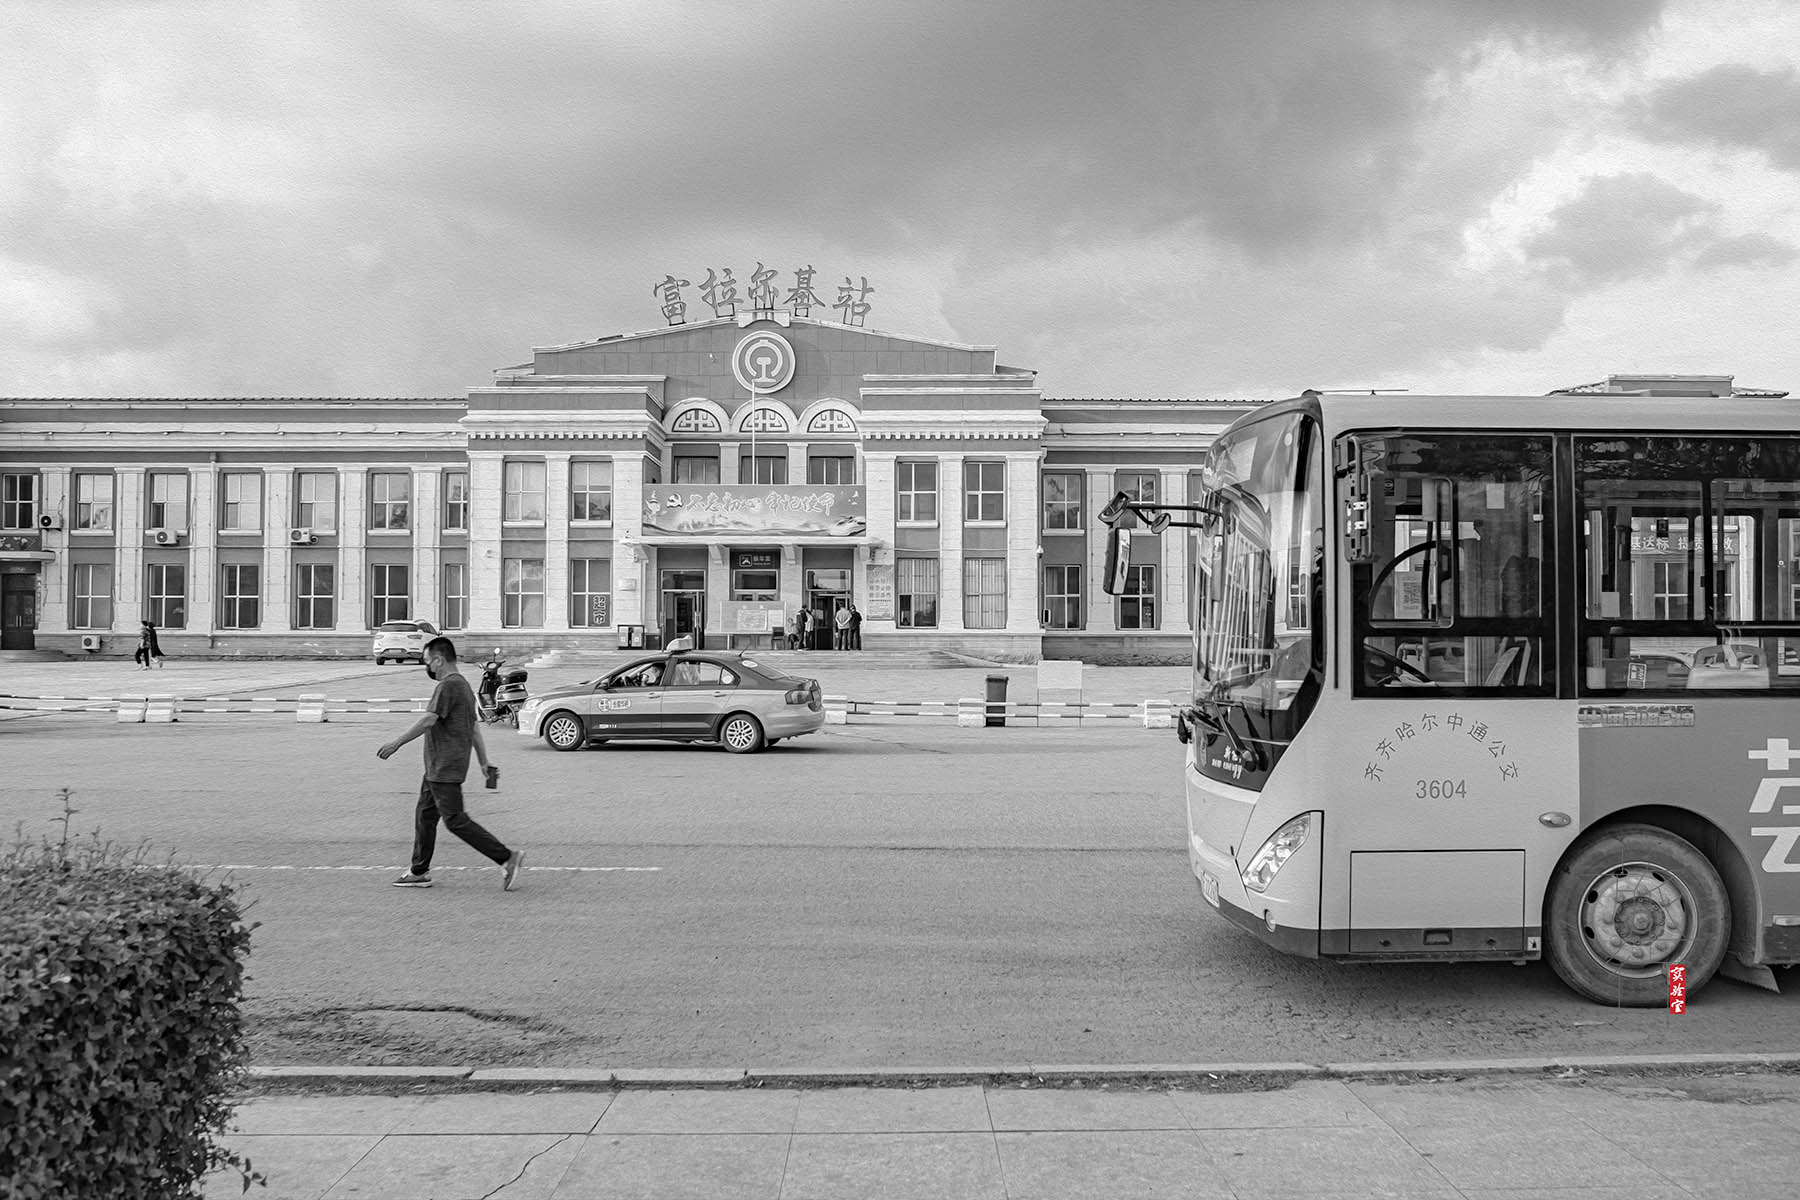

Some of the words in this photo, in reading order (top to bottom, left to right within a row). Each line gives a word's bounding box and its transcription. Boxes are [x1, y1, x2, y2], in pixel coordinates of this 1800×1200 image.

[653, 262, 875, 322] 富拉尔基站
[685, 491, 762, 514] 不忘初心
[765, 490, 836, 516] 牢记使命
[1364, 712, 1518, 782] 齐齐哈尔中通公交
[1416, 779, 1467, 799] 3604
